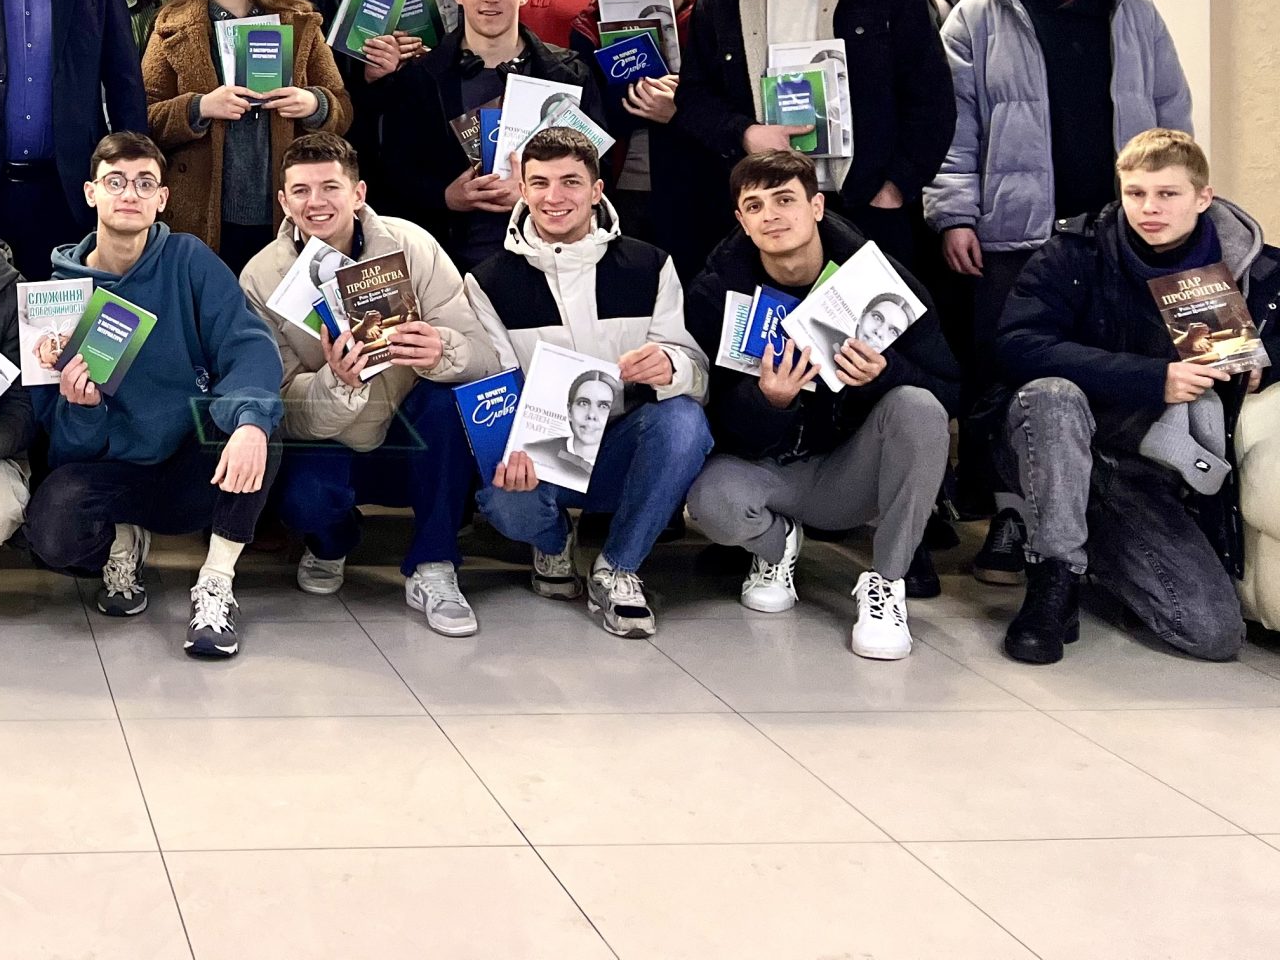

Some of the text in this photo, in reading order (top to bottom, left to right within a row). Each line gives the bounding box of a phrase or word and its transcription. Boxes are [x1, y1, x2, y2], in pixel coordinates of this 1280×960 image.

[563, 109, 604, 148] СЛУЖІННЯ
[346, 269, 404, 294] ПРОРОЦТВА
[362, 265, 381, 280] ДАР
[1178, 276, 1202, 290] ДАР
[28, 289, 83, 304] СЛУЖІННЯ
[1161, 281, 1231, 306] ПРОРОЦТВА
[472, 394, 516, 427] Слово
[523, 411, 550, 424] ЕЛЛЕН
[525, 404, 567, 422] РОЗУМІННЯ
